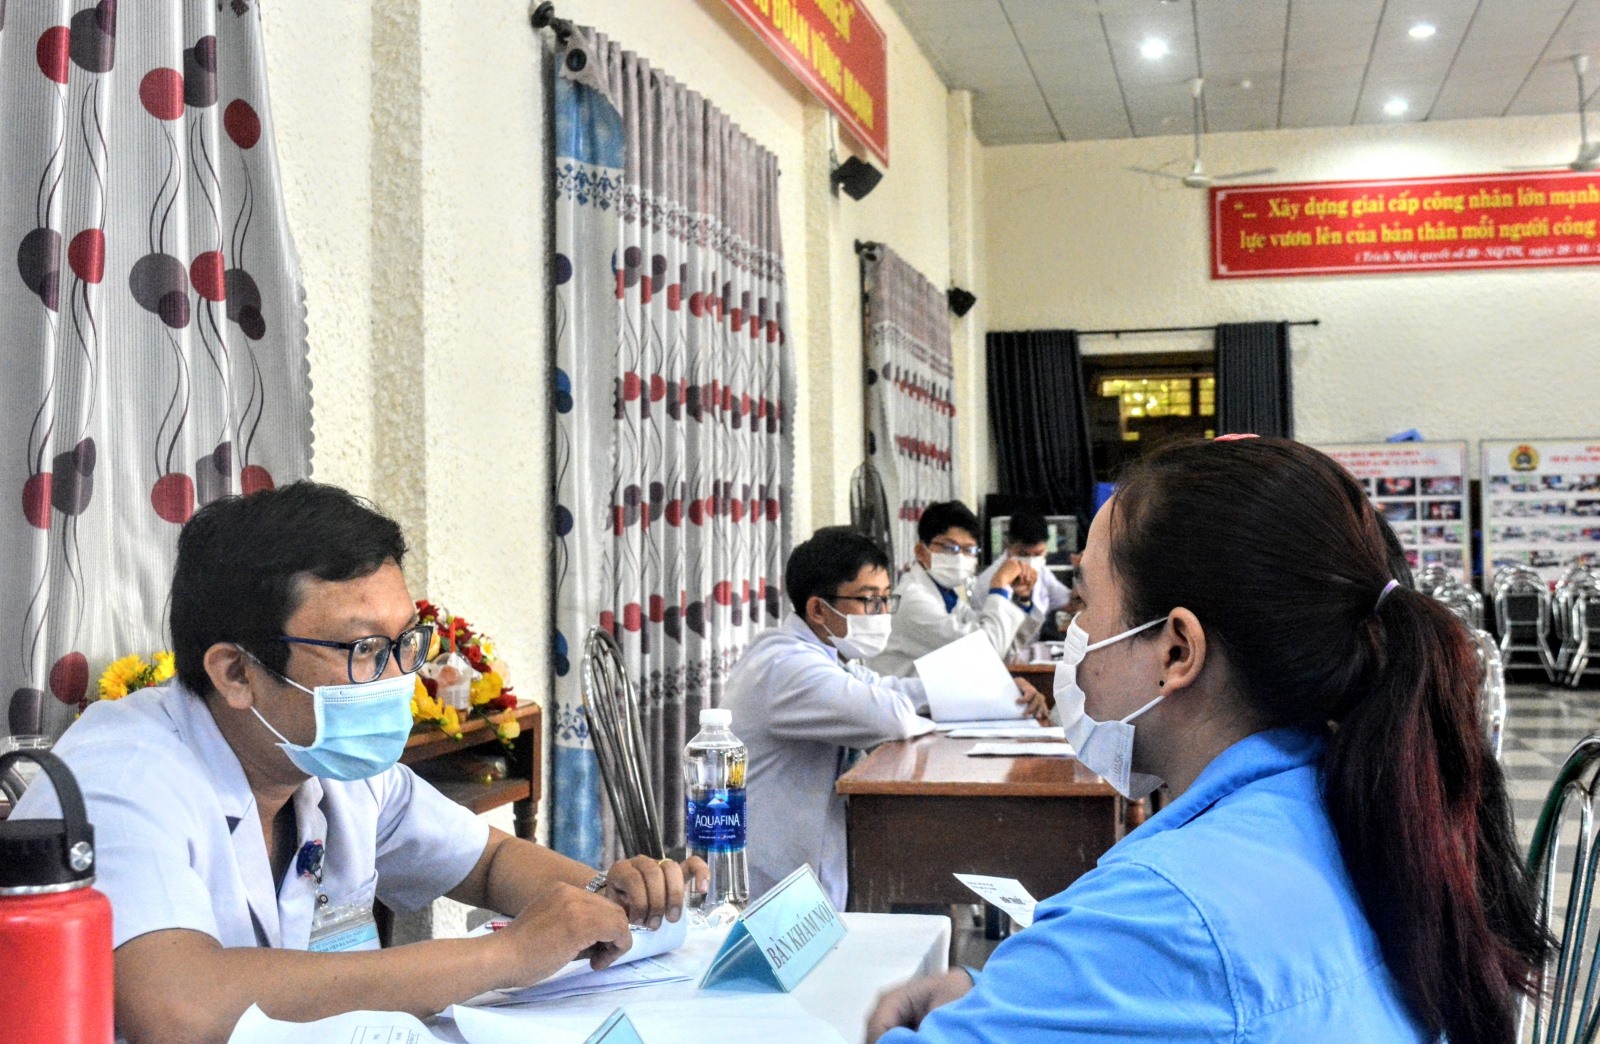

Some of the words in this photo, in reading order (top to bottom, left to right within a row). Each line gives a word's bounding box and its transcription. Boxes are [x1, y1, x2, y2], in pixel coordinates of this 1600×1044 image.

[1268, 198, 1300, 220] Xây
[1304, 196, 1349, 219] dựng
[1352, 193, 1385, 218] giai
[1388, 189, 1419, 215] cấp
[1423, 190, 1465, 213] công
[1469, 187, 1514, 208] nhân
[1517, 187, 1546, 206] lớn
[1550, 183, 1600, 209] mạnh
[1240, 230, 1266, 253] lực
[1270, 231, 1313, 247] vươn
[1316, 226, 1343, 245] lên
[1346, 222, 1377, 244] của
[1381, 221, 1414, 242] bản
[1417, 221, 1458, 241] thân
[1461, 215, 1495, 239] mỗi
[1499, 217, 1550, 242] người
[1553, 215, 1597, 239] công
[695, 813, 741, 828] AQUAFINA
[766, 936, 794, 969] BÀN
[786, 914, 821, 951] KHÁM
[812, 901, 834, 928] NỘI
